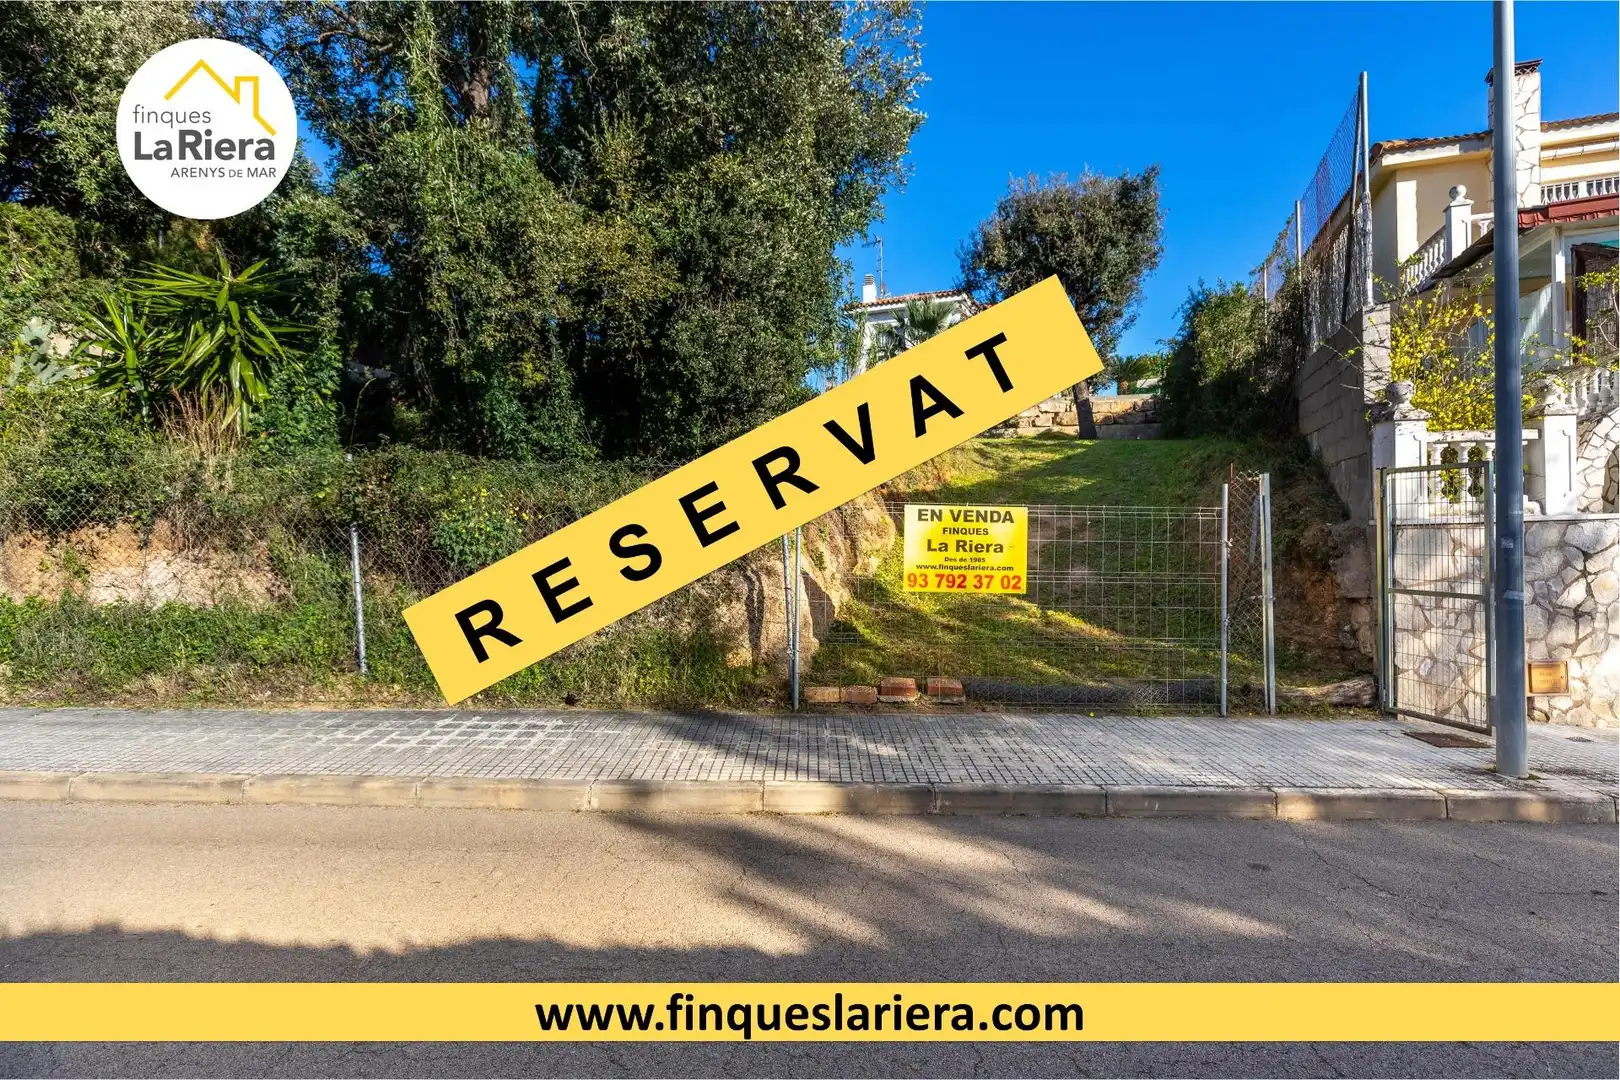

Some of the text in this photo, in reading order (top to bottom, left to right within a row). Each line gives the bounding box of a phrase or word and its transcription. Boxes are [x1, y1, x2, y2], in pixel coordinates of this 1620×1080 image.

[917, 508, 1015, 524] EN VENDA
[942, 527, 989, 536] FINQUES
[927, 538, 1004, 553] La Riera
[916, 563, 1014, 572] www.finqueslariera.com
[907, 573, 1022, 590] 93 792 37 02
